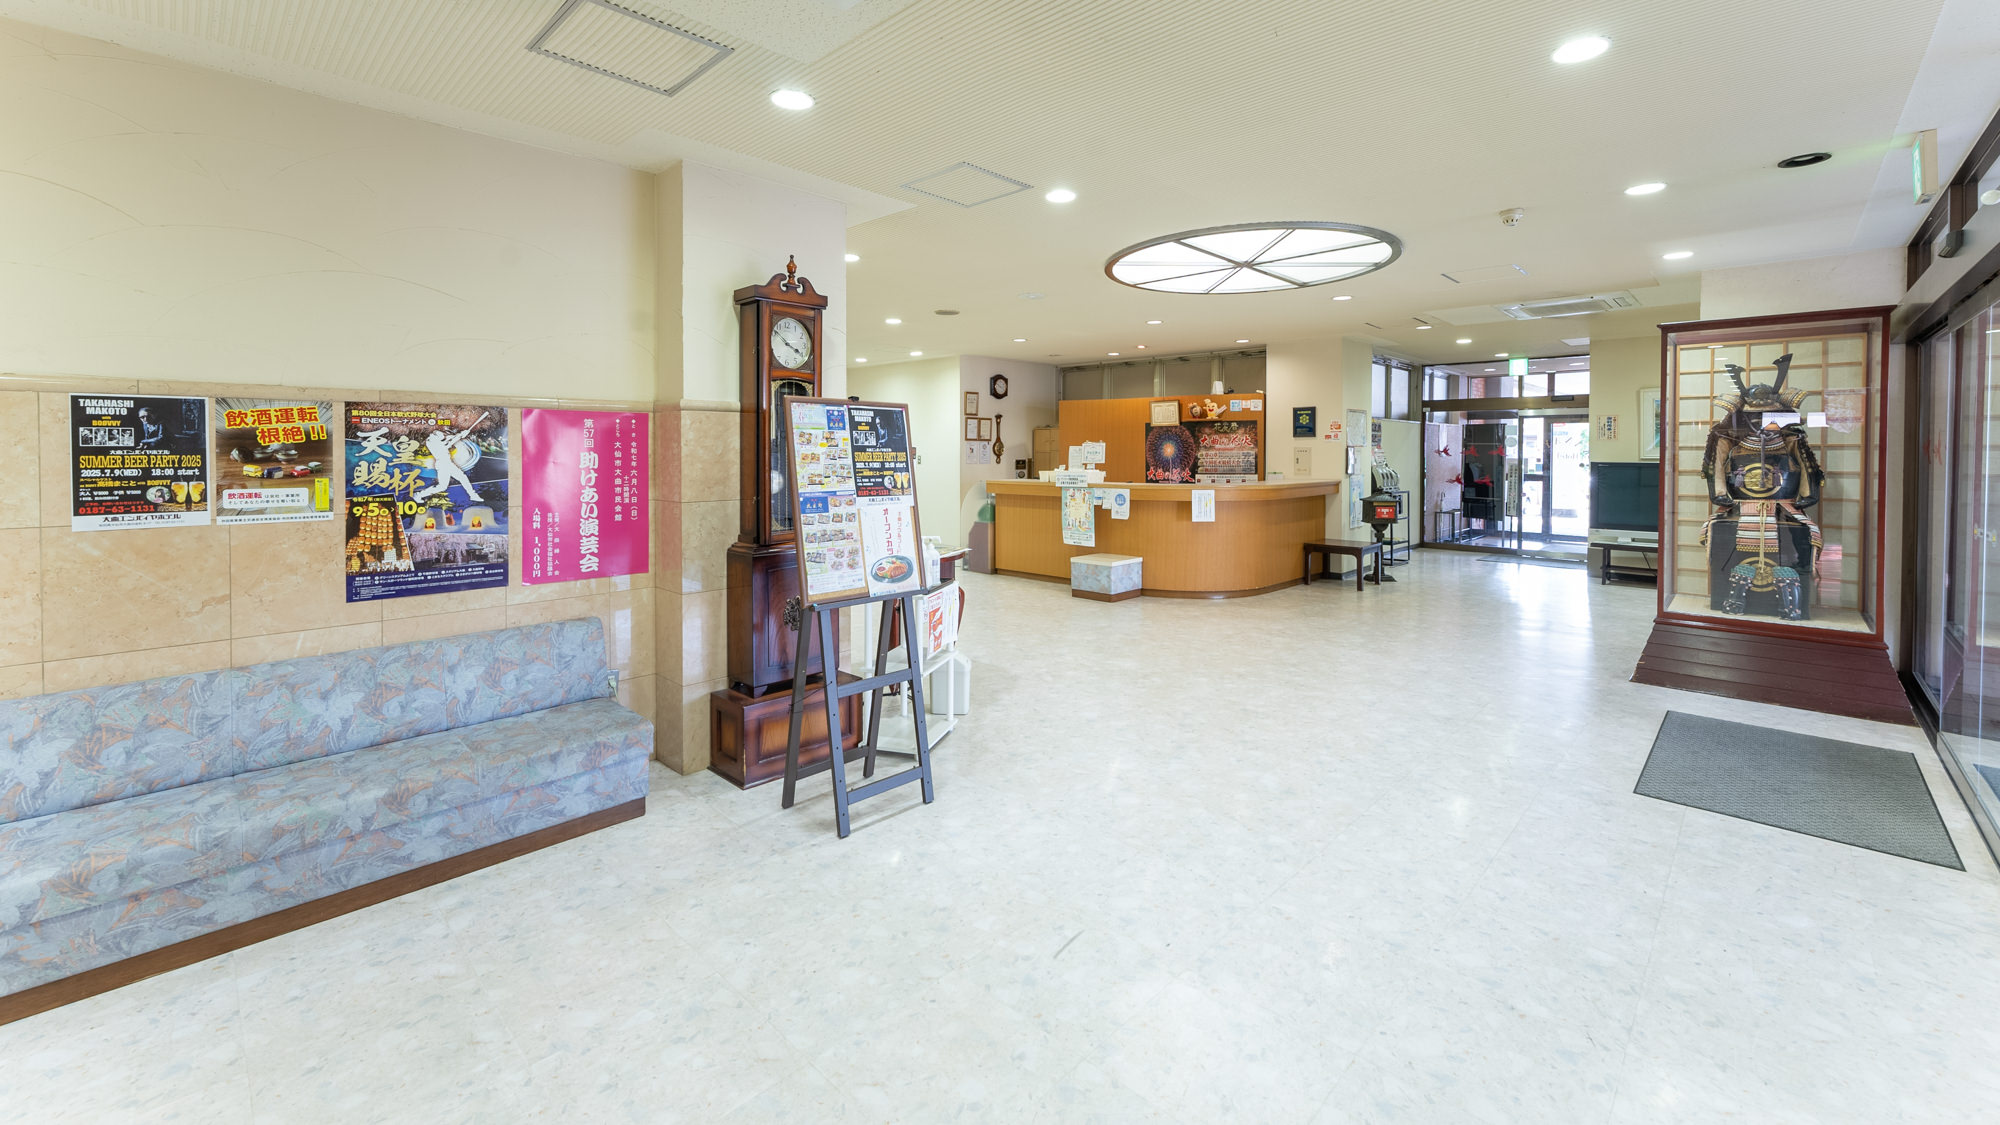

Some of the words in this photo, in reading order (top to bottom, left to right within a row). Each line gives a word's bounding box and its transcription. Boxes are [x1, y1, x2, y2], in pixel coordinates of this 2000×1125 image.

[78, 398, 134, 408] TAKAHASHI
[86, 407, 128, 415] MAKOTO
[224, 406, 319, 428] 飲酒運転
[583, 419, 594, 448] 第57回
[1200, 434, 1254, 447] 大曲の花火
[80, 456, 123, 468] SUMMER
[124, 455, 148, 468] BEER
[150, 455, 180, 467] PARTY
[181, 455, 202, 467] 2025
[80, 469, 142, 477] 2025.7.9(WED)
[151, 468, 174, 476] 18:00
[1147, 467, 1195, 482] 大曲の花火
[614, 442, 622, 522] 大仙市大曲市民会館
[227, 492, 262, 500] 飲酒運転
[79, 505, 155, 514] 0187-63-1131
[579, 451, 599, 572] 助けあい演芸会
[532, 508, 541, 529] 入場料
